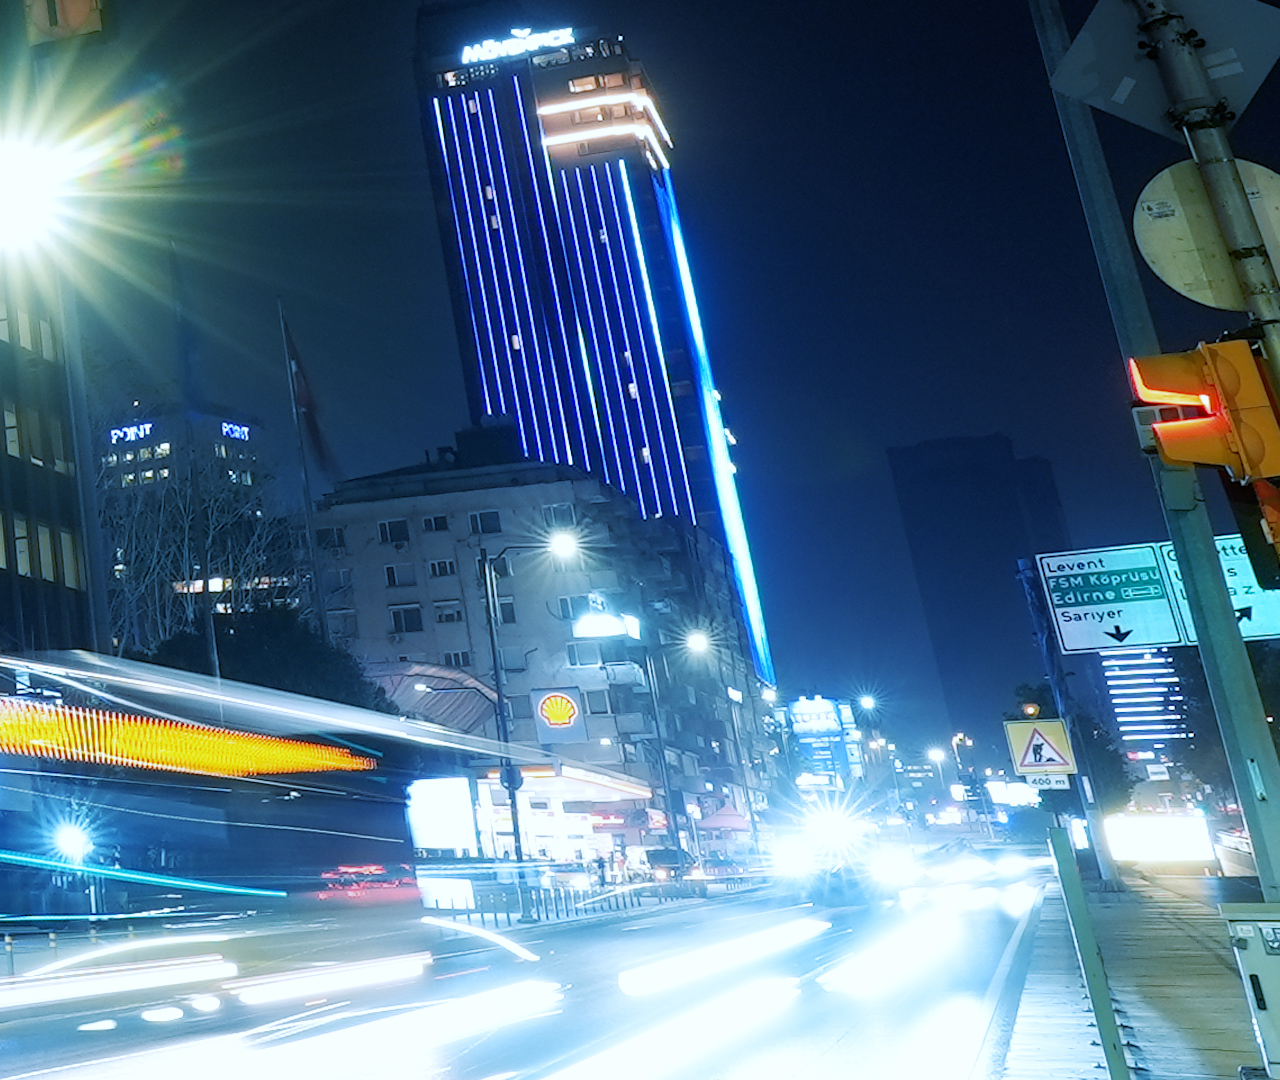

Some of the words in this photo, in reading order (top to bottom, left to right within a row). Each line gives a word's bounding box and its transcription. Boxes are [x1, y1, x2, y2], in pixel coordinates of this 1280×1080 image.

[110, 422, 153, 444] POINT
[1047, 557, 1106, 573] Levent
[1049, 576, 1084, 589] FSM
[1052, 590, 1116, 605] Edirne
[1031, 777, 1052, 786] 400
